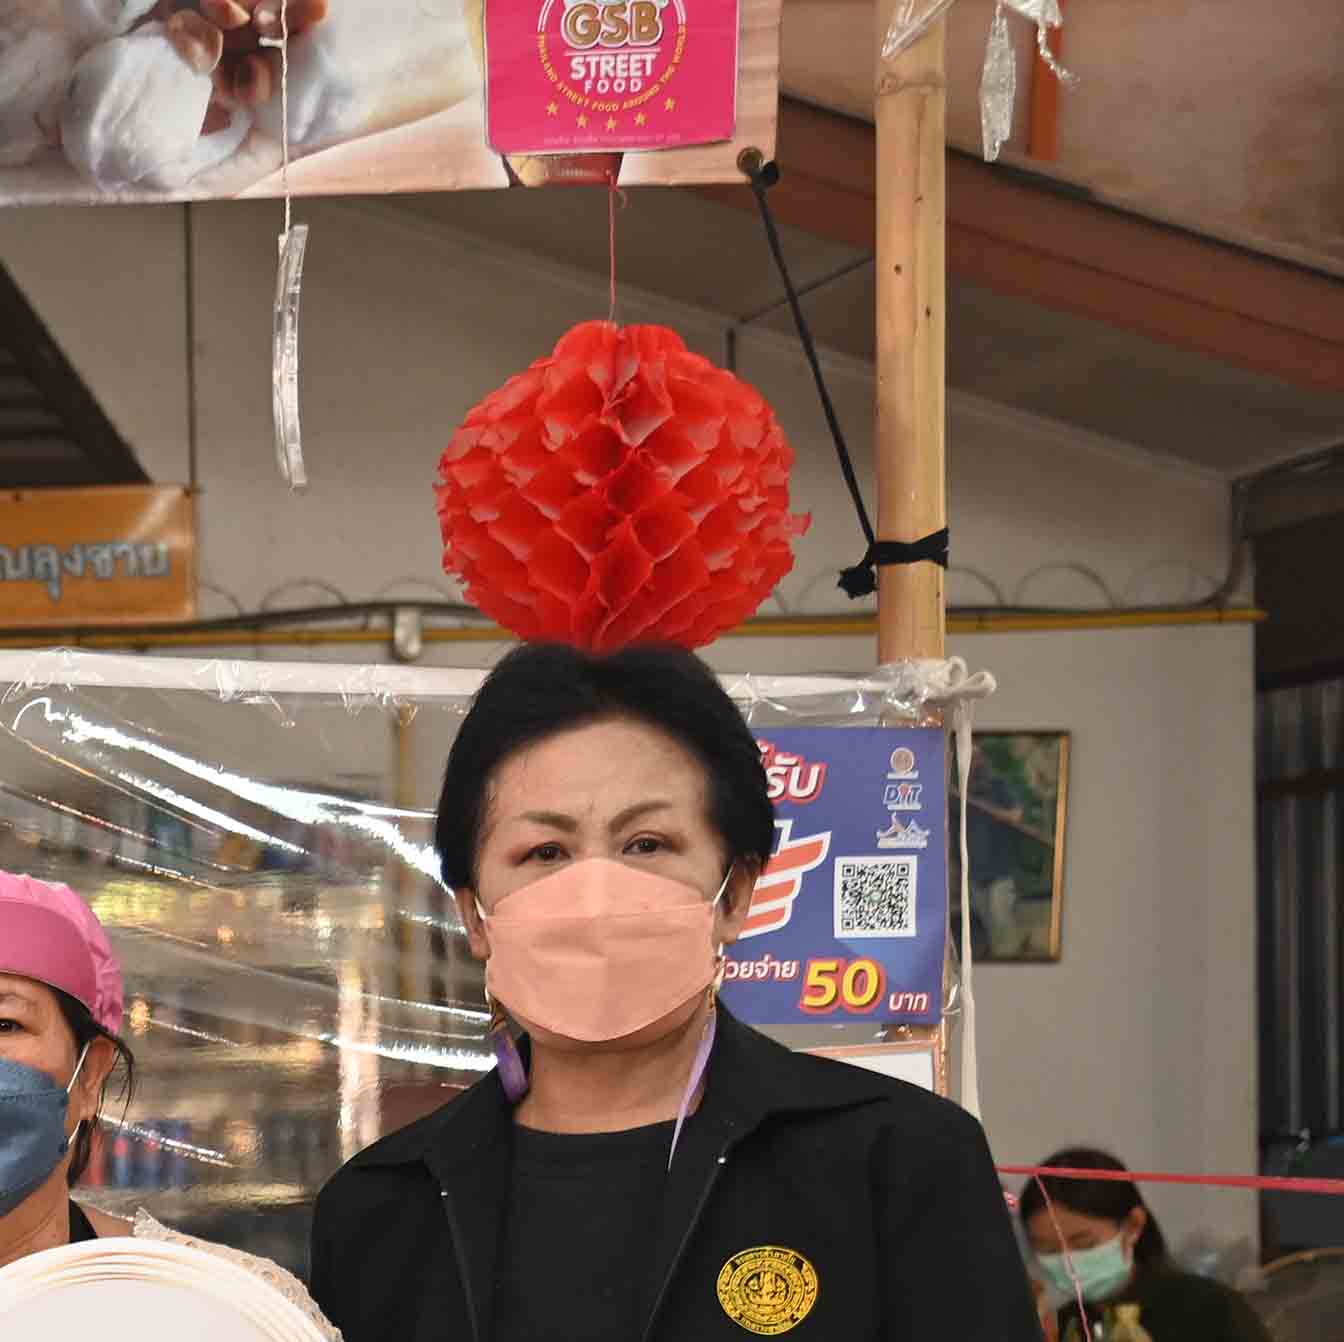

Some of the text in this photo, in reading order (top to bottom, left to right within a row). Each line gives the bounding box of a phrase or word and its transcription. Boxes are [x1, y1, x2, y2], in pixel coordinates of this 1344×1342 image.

[562, 1, 662, 48] GSB
[570, 53, 657, 80] STREET
[584, 79, 643, 94] FOOD
[802, 957, 882, 1010] 50
[888, 992, 929, 1012] บาท
